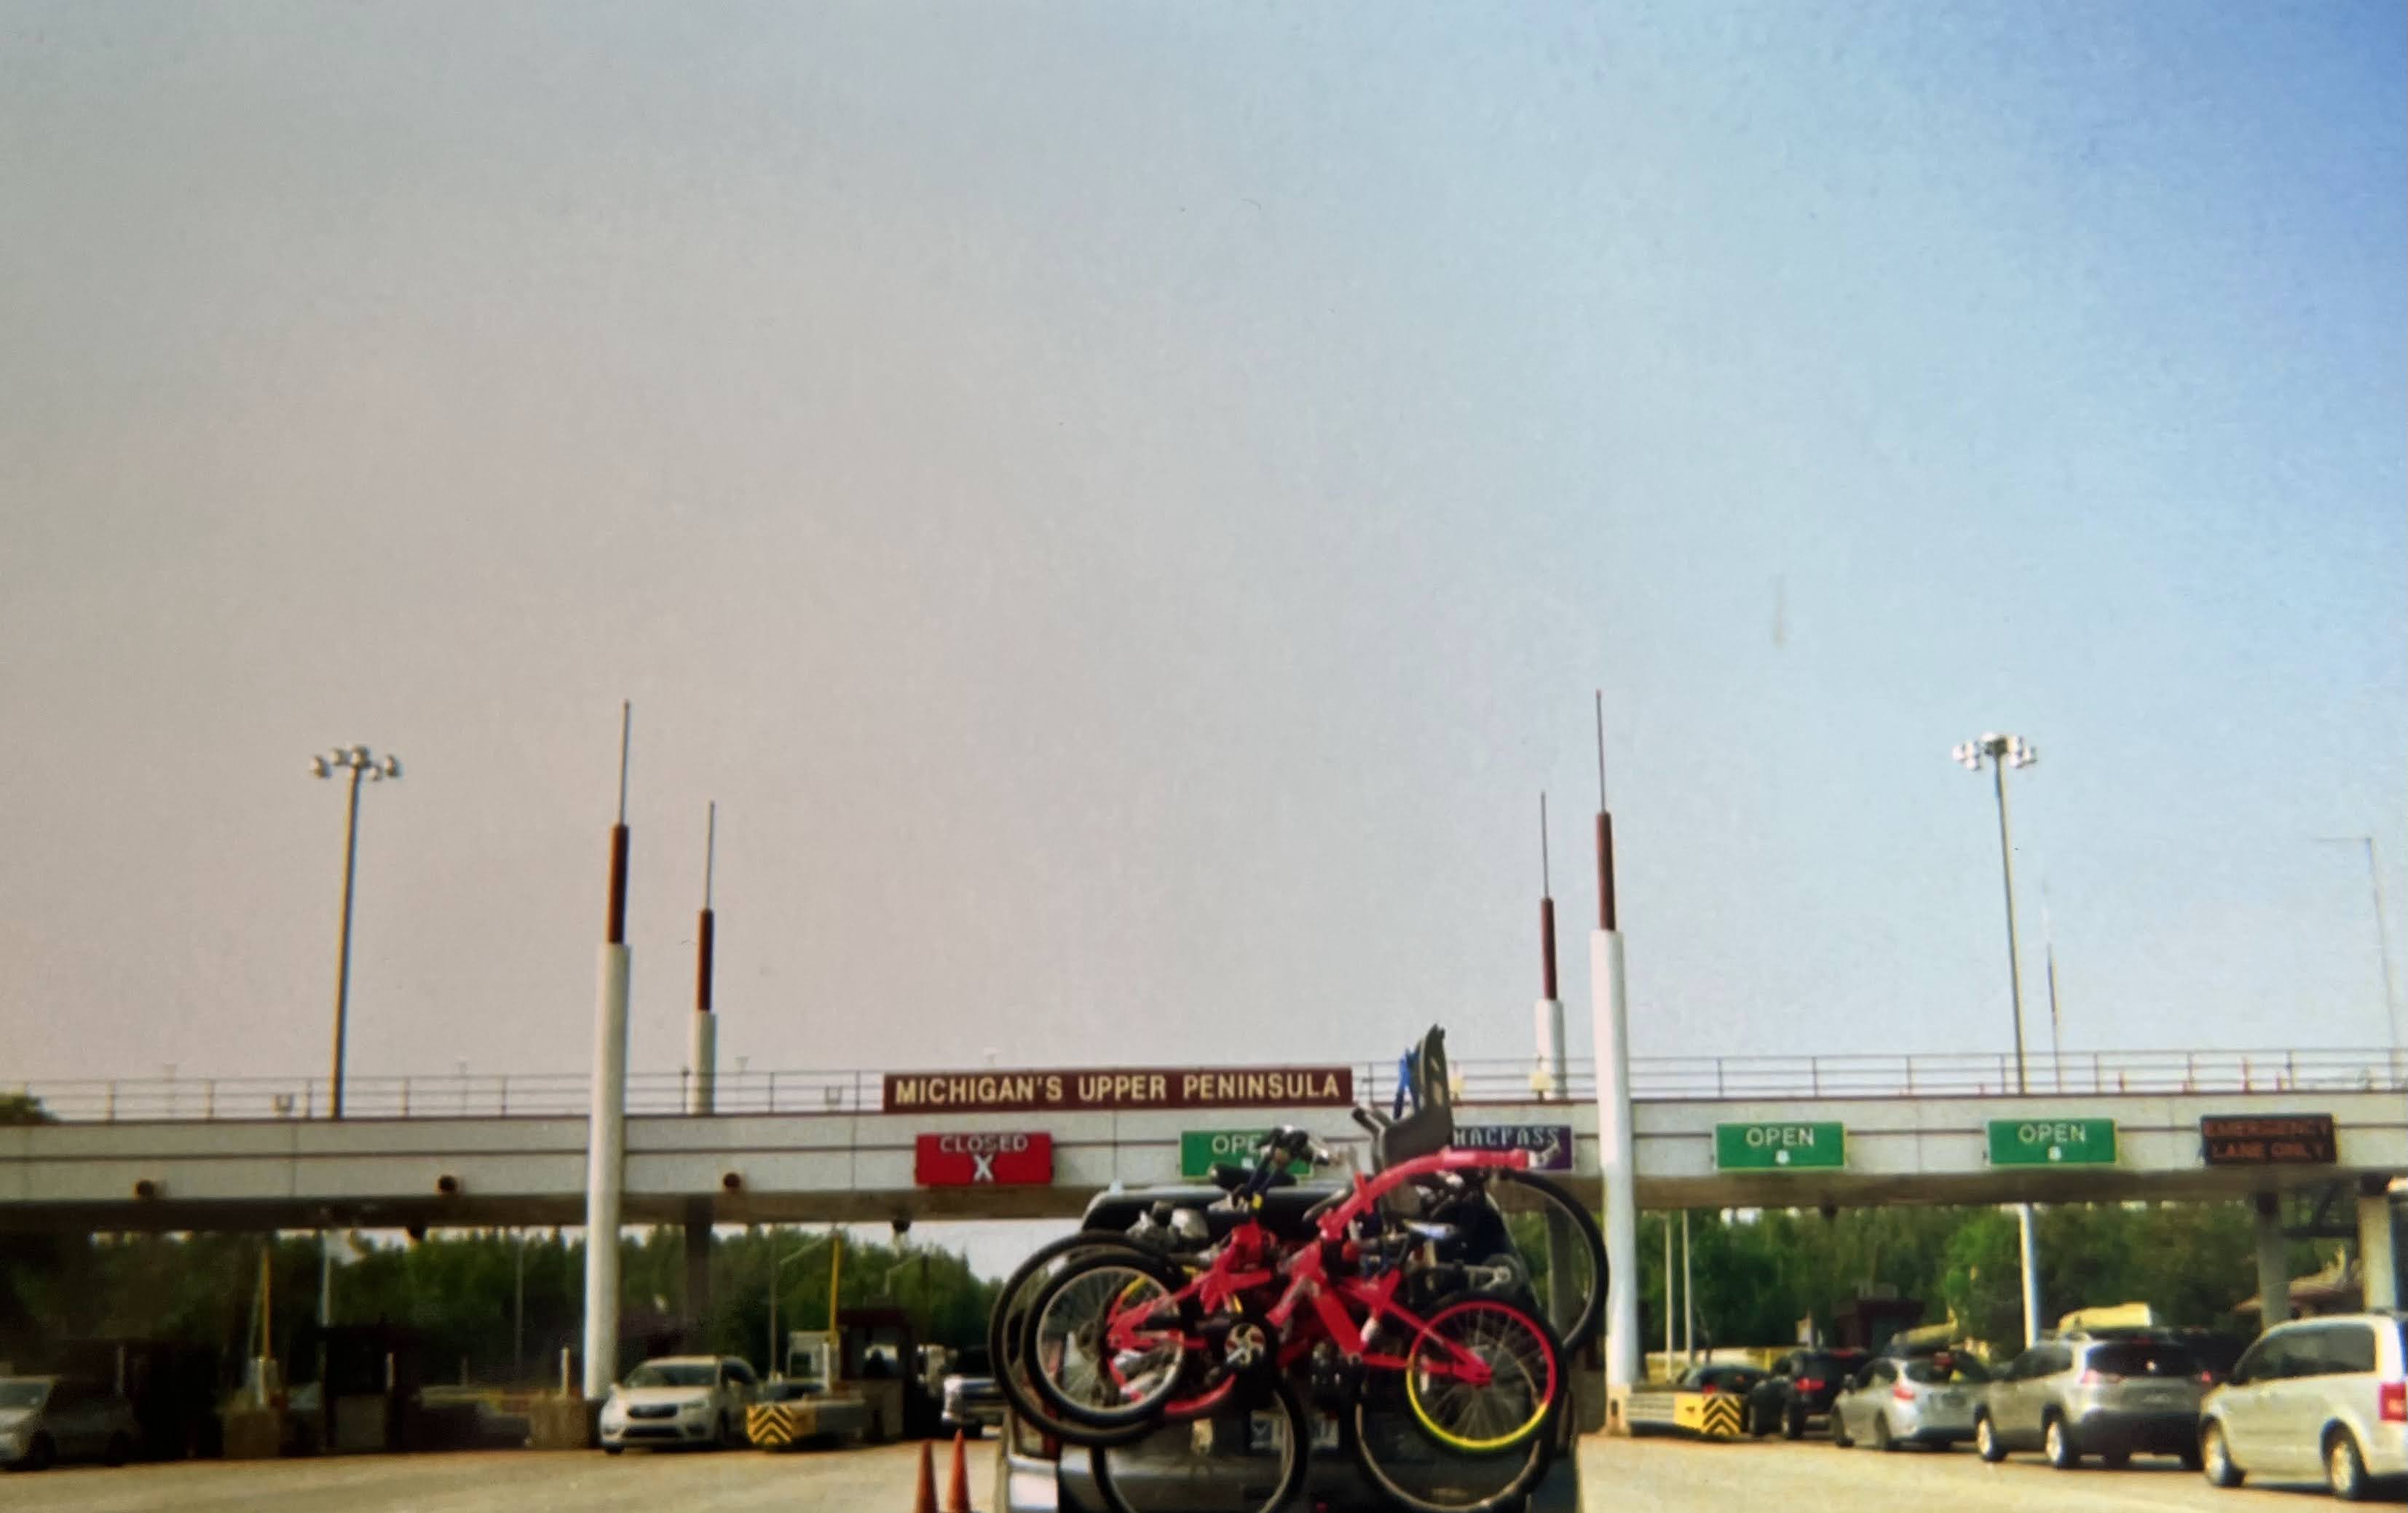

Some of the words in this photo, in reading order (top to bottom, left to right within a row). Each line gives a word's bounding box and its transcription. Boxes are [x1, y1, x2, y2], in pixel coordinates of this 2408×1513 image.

[895, 1075, 1063, 1104] MICHIGAN'S
[1078, 1074, 1167, 1101] UPPER
[1182, 1072, 1341, 1099] PENINSULA
[939, 1134, 1030, 1153] CLOSED
[1745, 1126, 1815, 1147] OPEN
[2018, 1123, 2087, 1145] OPEN
